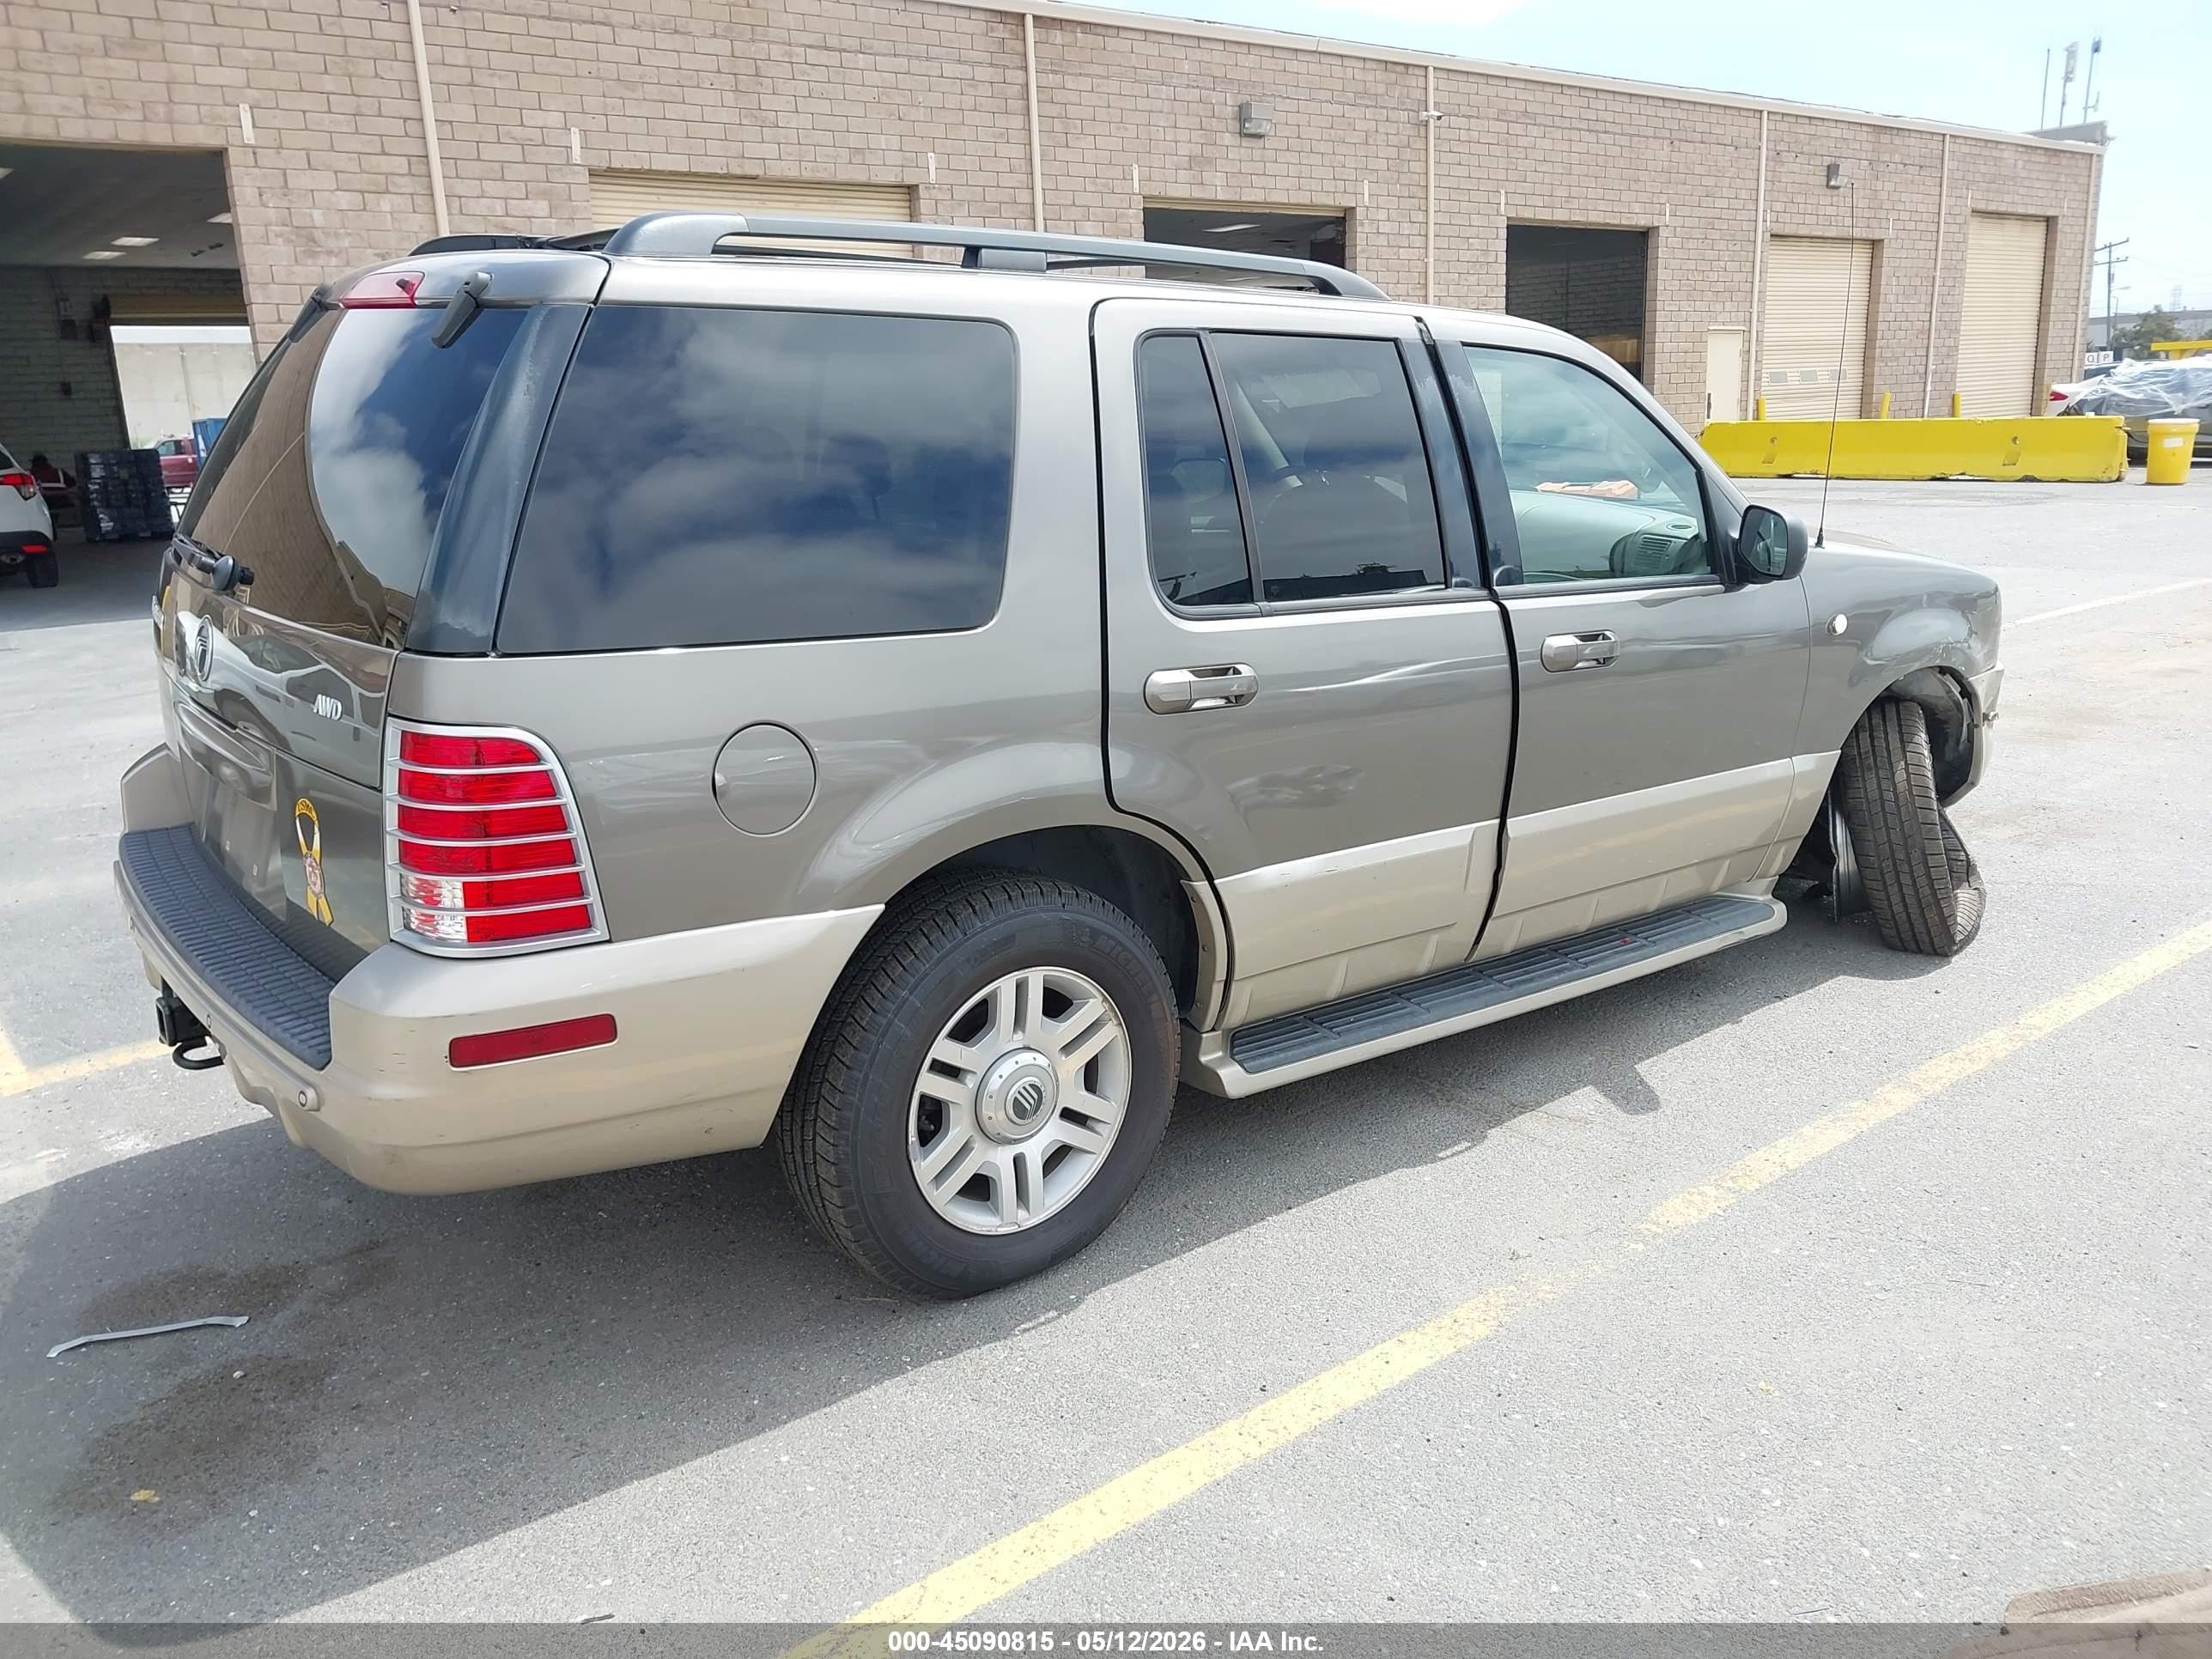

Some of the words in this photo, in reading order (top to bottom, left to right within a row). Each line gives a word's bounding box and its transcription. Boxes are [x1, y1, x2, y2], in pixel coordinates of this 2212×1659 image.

[2103, 353, 2110, 362] P
[310, 693, 343, 721] AWD
[297, 799, 315, 818] USM
